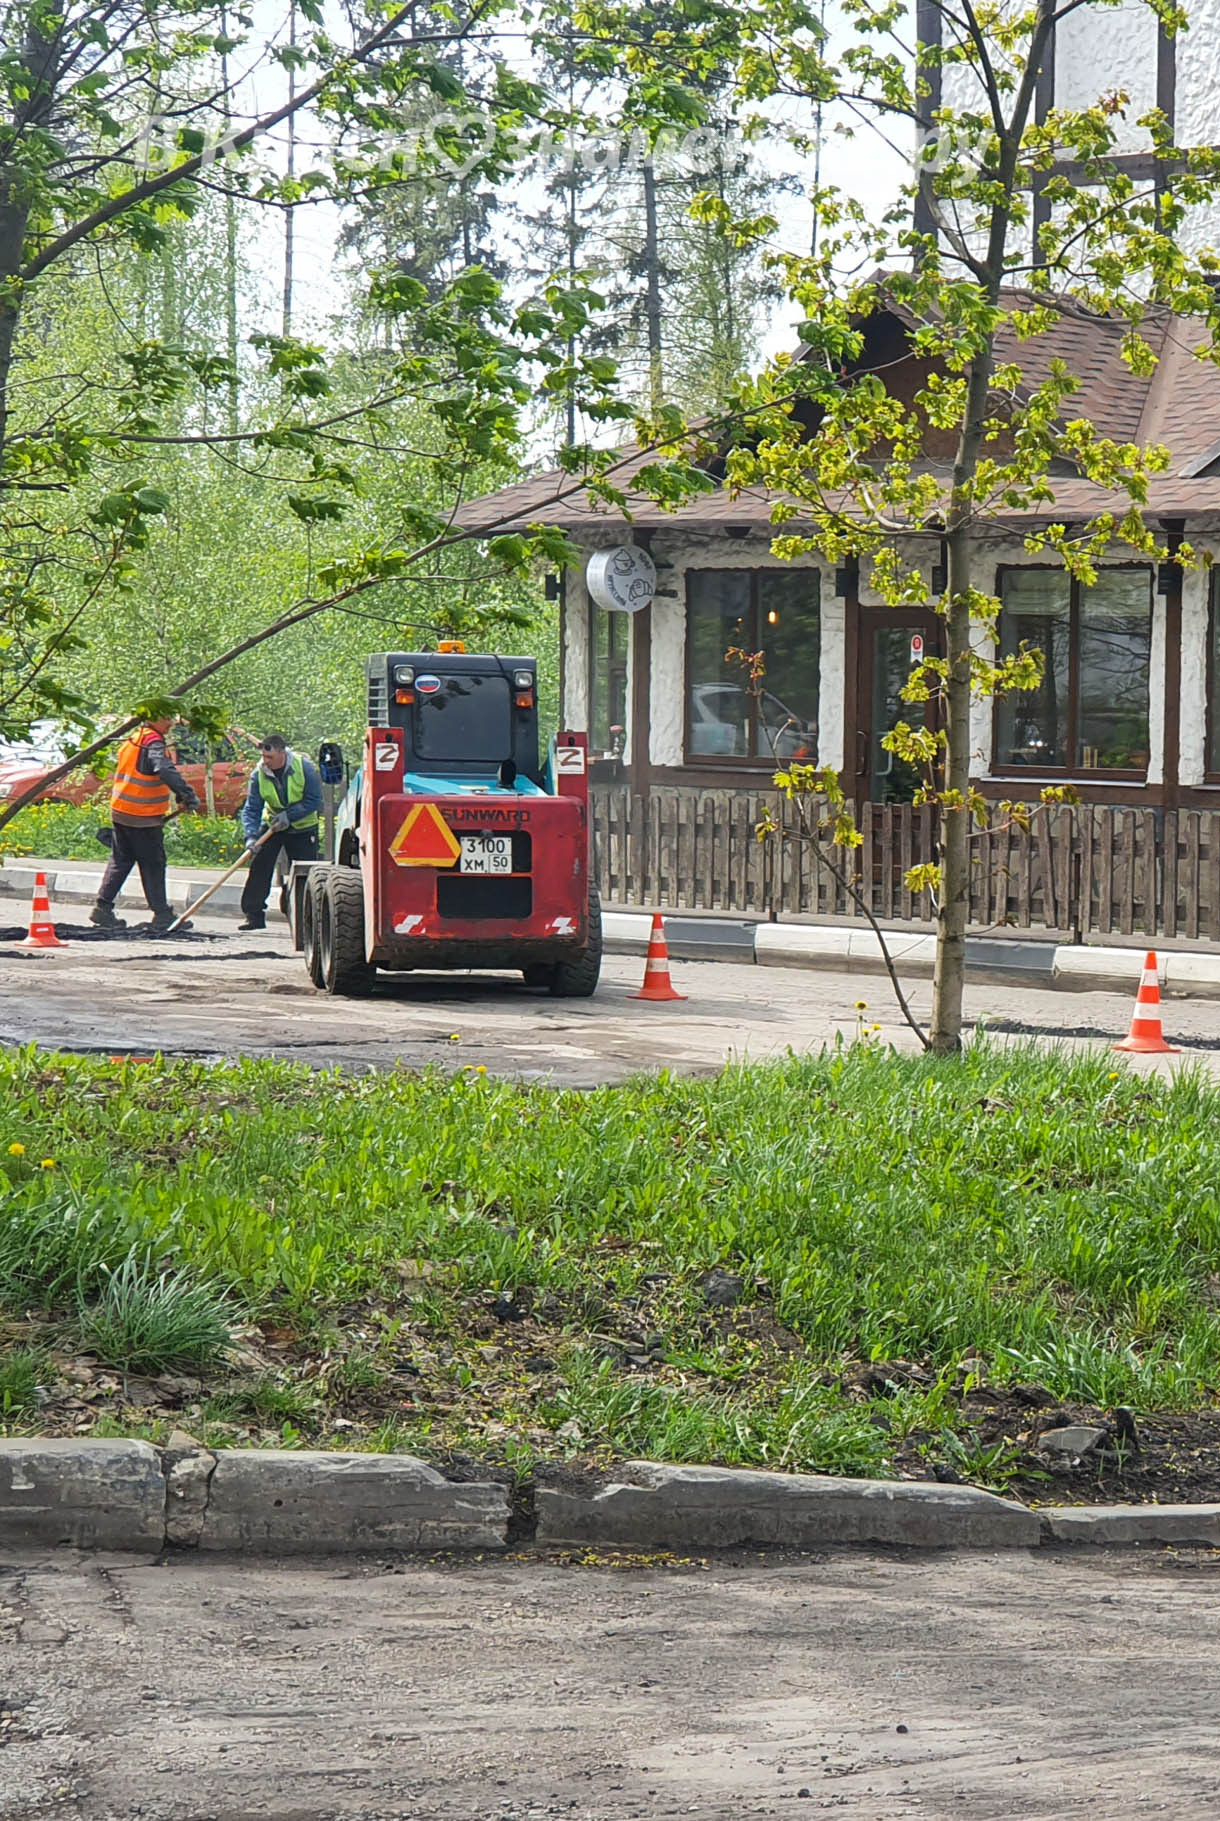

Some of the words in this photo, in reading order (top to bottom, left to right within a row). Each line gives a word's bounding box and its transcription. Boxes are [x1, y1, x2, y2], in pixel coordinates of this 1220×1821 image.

[558, 748, 583, 767] Z
[441, 808, 531, 823] SUNWARD
[466, 839, 506, 854] 3100
[492, 856, 508, 868] 50
